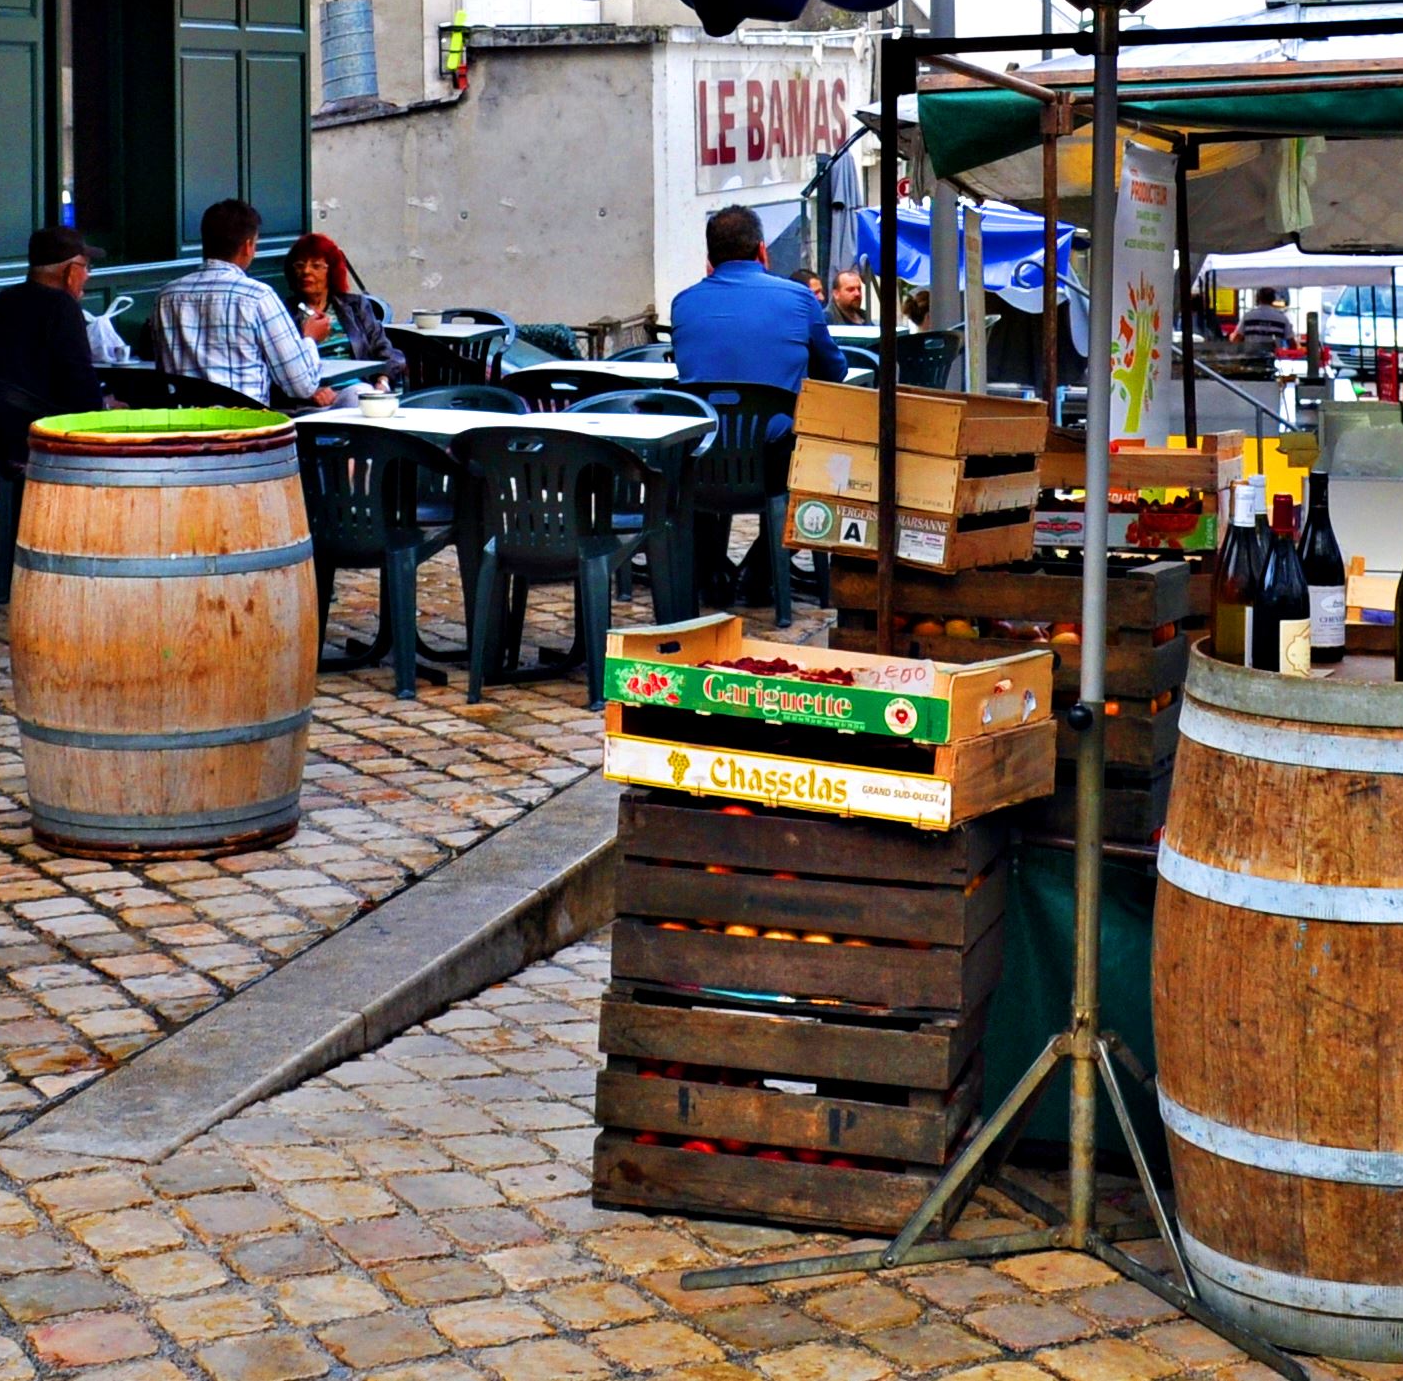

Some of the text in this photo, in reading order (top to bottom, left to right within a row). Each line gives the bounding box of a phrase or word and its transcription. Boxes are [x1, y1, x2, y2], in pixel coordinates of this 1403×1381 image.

[699, 77, 847, 166] LE BAMAS
[836, 504, 878, 521] VERGERS
[843, 522, 862, 543] A
[702, 672, 853, 719] Gariguette
[709, 755, 848, 804] Chasselas
[861, 784, 940, 804] GRAND SUD-OUEST
